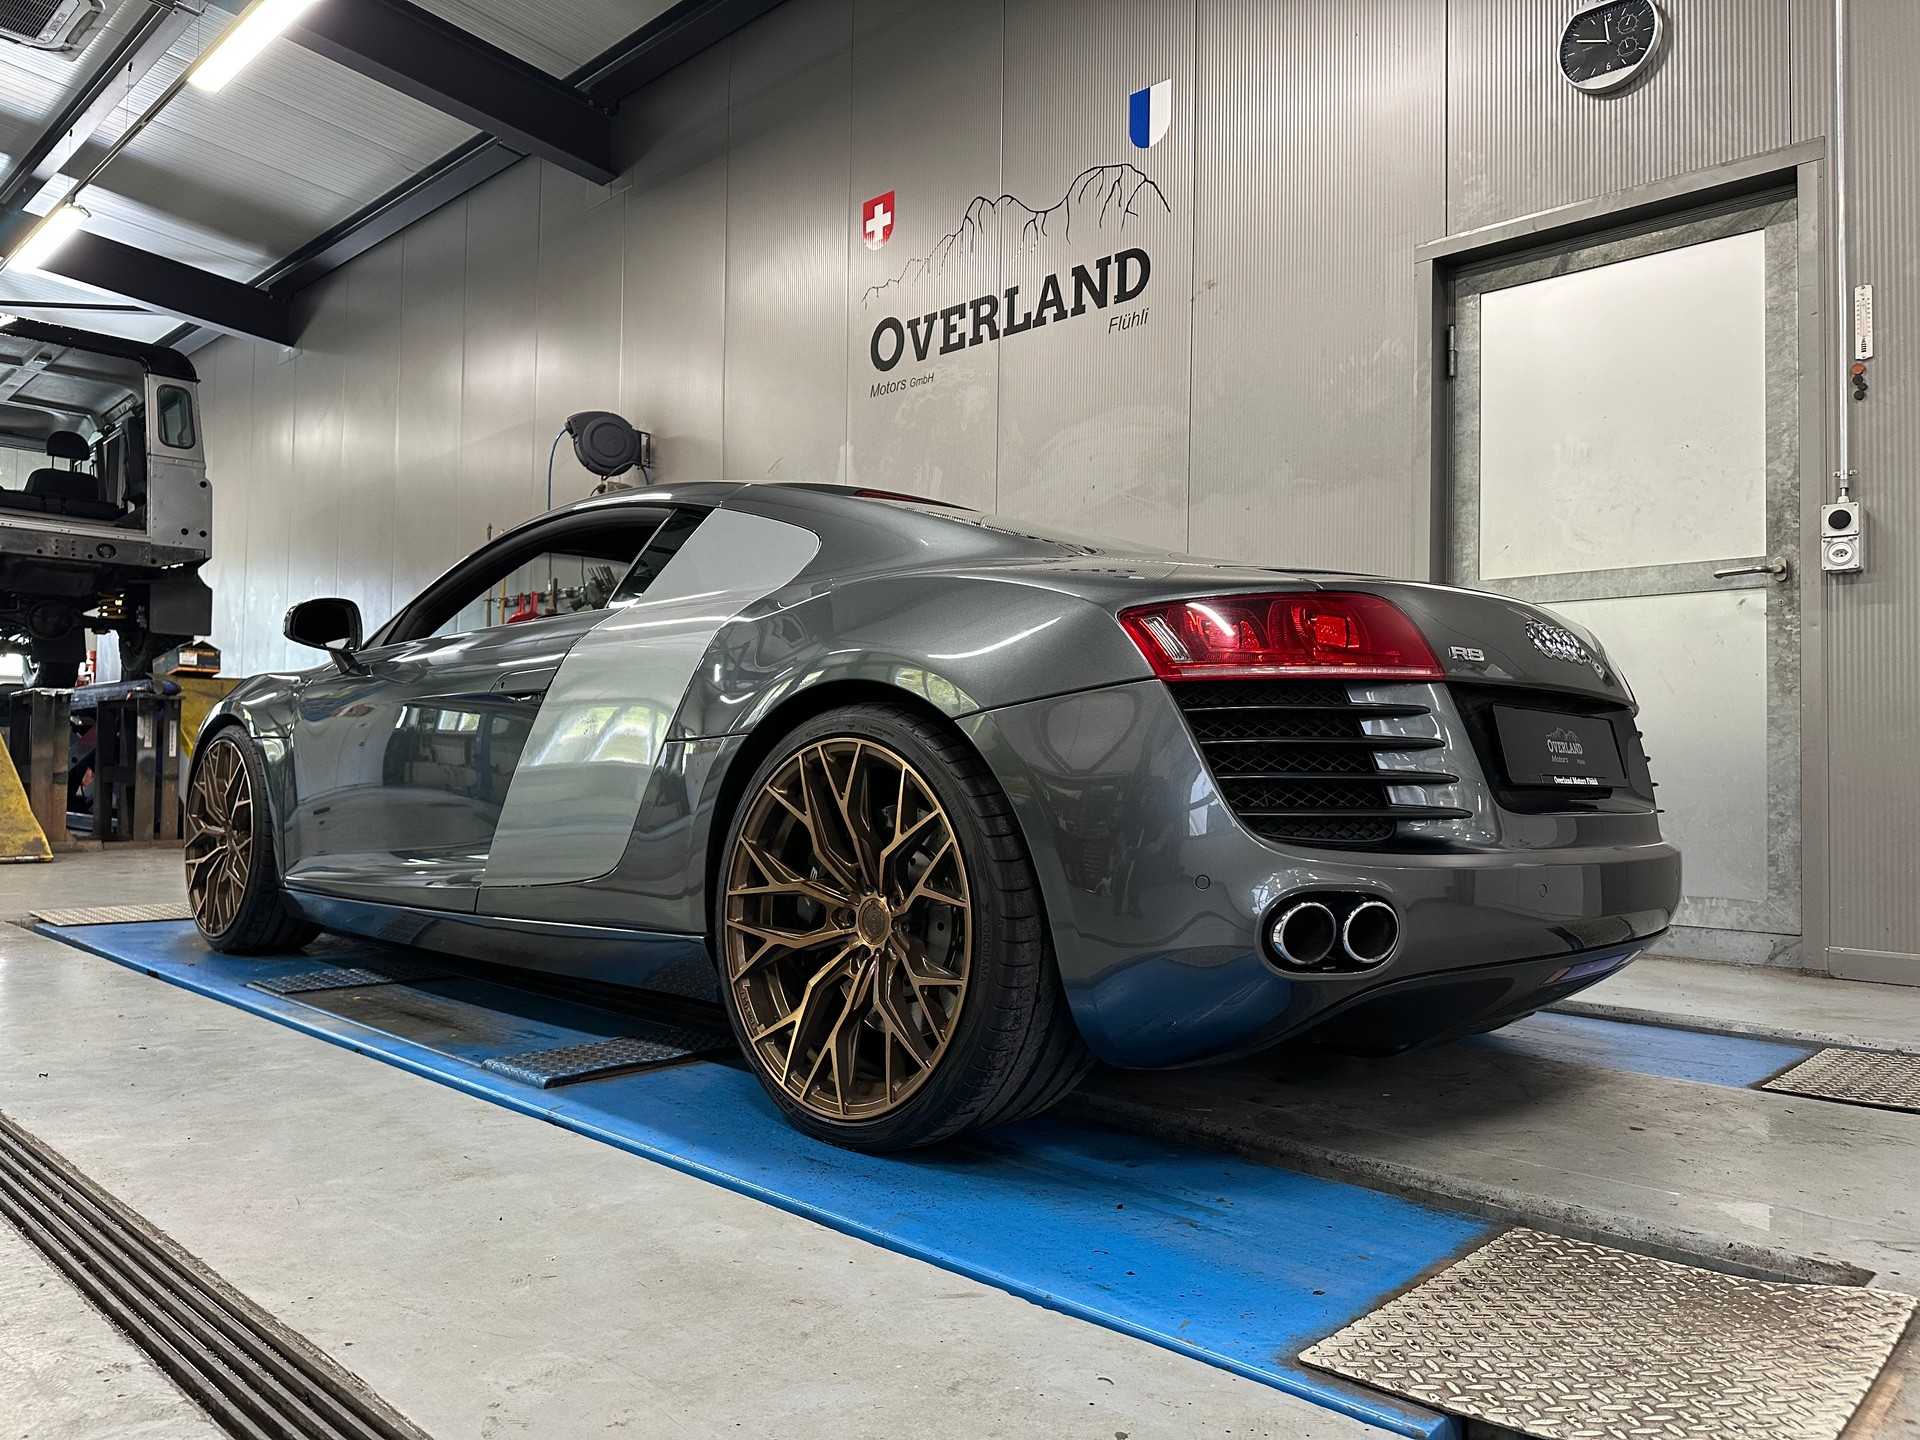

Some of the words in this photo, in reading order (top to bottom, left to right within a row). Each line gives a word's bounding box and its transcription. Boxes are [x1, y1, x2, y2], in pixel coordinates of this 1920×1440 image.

[1606, 62, 1611, 71] 6
[870, 247, 1151, 372] OVERLAND
[1108, 307, 1149, 334] Flühli
[869, 378, 907, 398] Motors
[909, 372, 935, 388] GmbH
[1448, 645, 1485, 661] R8
[1547, 738, 1583, 755] OVERLAND
[1551, 755, 1569, 764] Motors
[979, 918, 992, 984] YOKOHAMA
